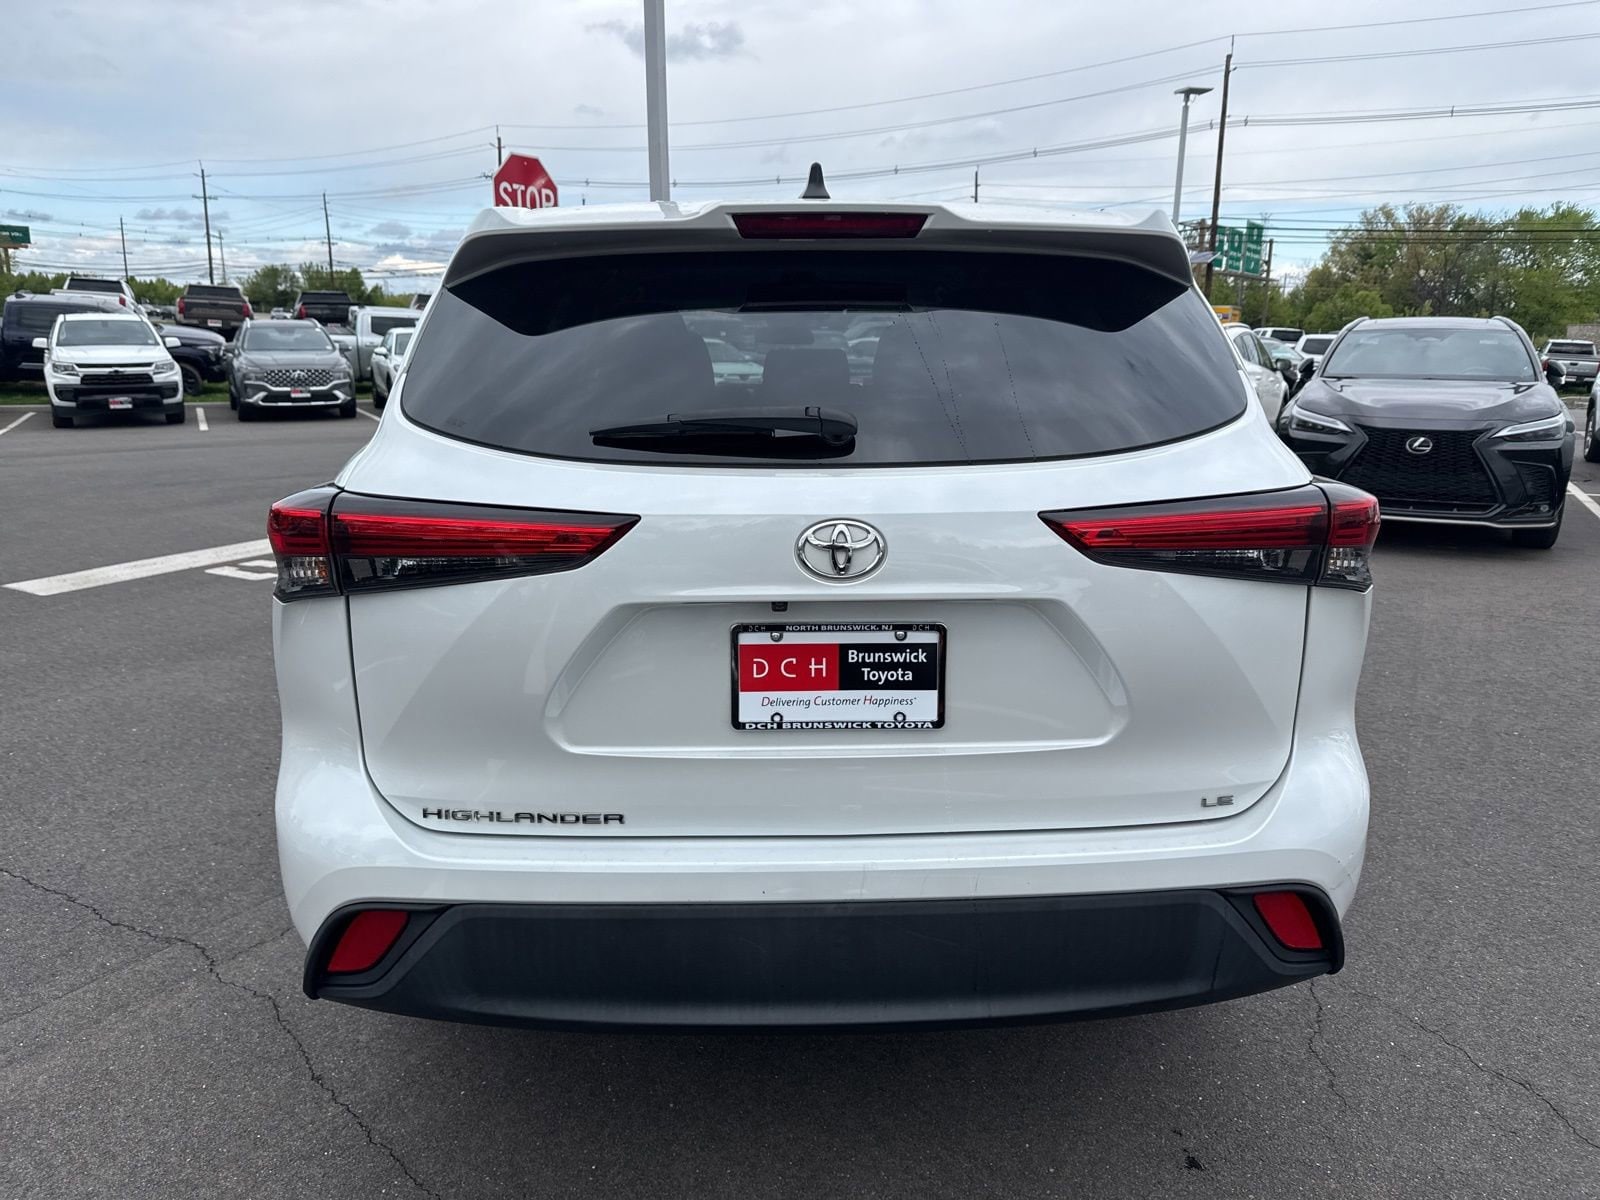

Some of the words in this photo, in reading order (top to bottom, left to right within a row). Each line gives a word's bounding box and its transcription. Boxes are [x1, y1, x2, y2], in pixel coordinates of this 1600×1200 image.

[499, 181, 554, 208] STOP
[848, 648, 928, 663] Brunswick
[861, 667, 913, 685] Toyota
[761, 696, 811, 709] Delivering
[813, 695, 861, 706] Customer
[745, 722, 778, 730] DCH
[782, 721, 873, 729] BRUNSWICK
[875, 721, 933, 729] TOYOTA
[1200, 795, 1234, 808] LE
[422, 807, 626, 825] HIGHLANDER
